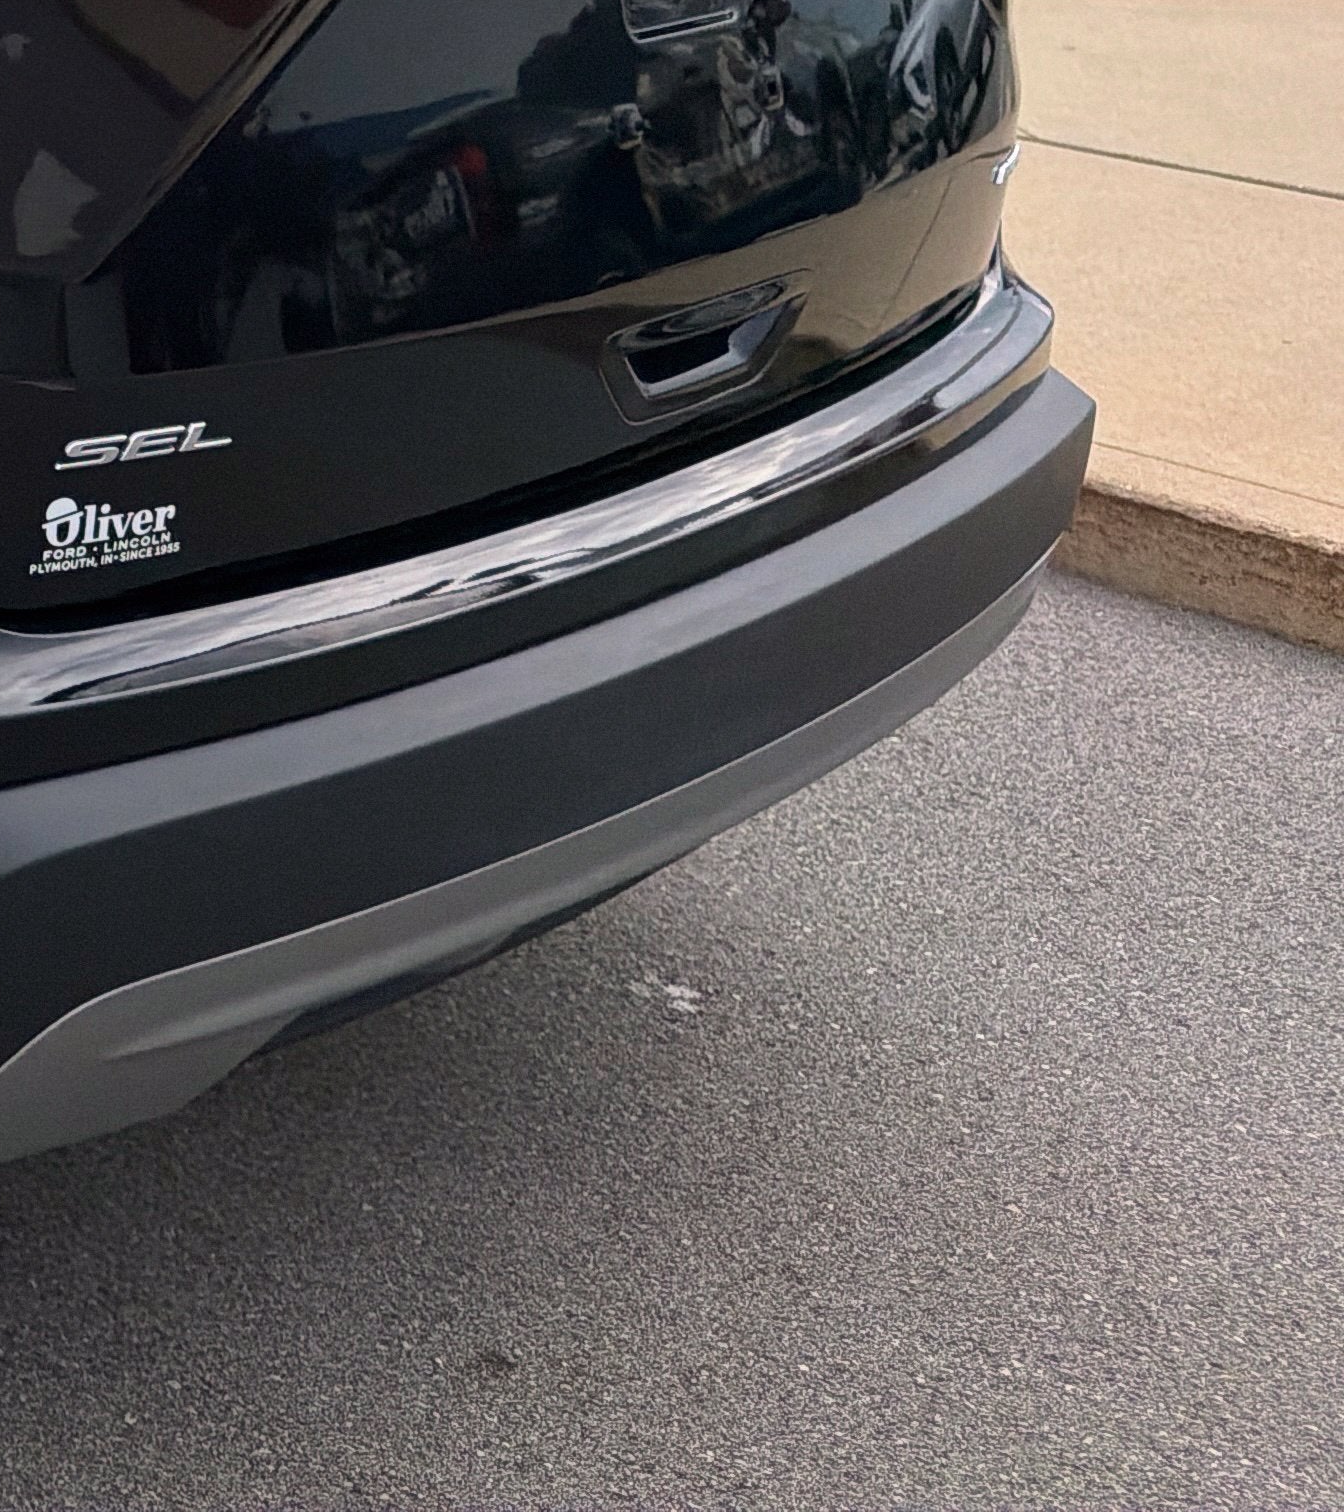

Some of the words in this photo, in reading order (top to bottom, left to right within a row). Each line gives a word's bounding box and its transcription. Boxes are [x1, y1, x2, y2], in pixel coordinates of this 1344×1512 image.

[54, 421, 233, 471] SEL
[41, 497, 177, 547] Oliver
[28, 556, 99, 576] PLYMOUTH,
[119, 547, 153, 563] SINCE
[154, 541, 181, 556] 1955
[42, 545, 87, 562] FORD
[103, 531, 172, 553] LINCOLN
